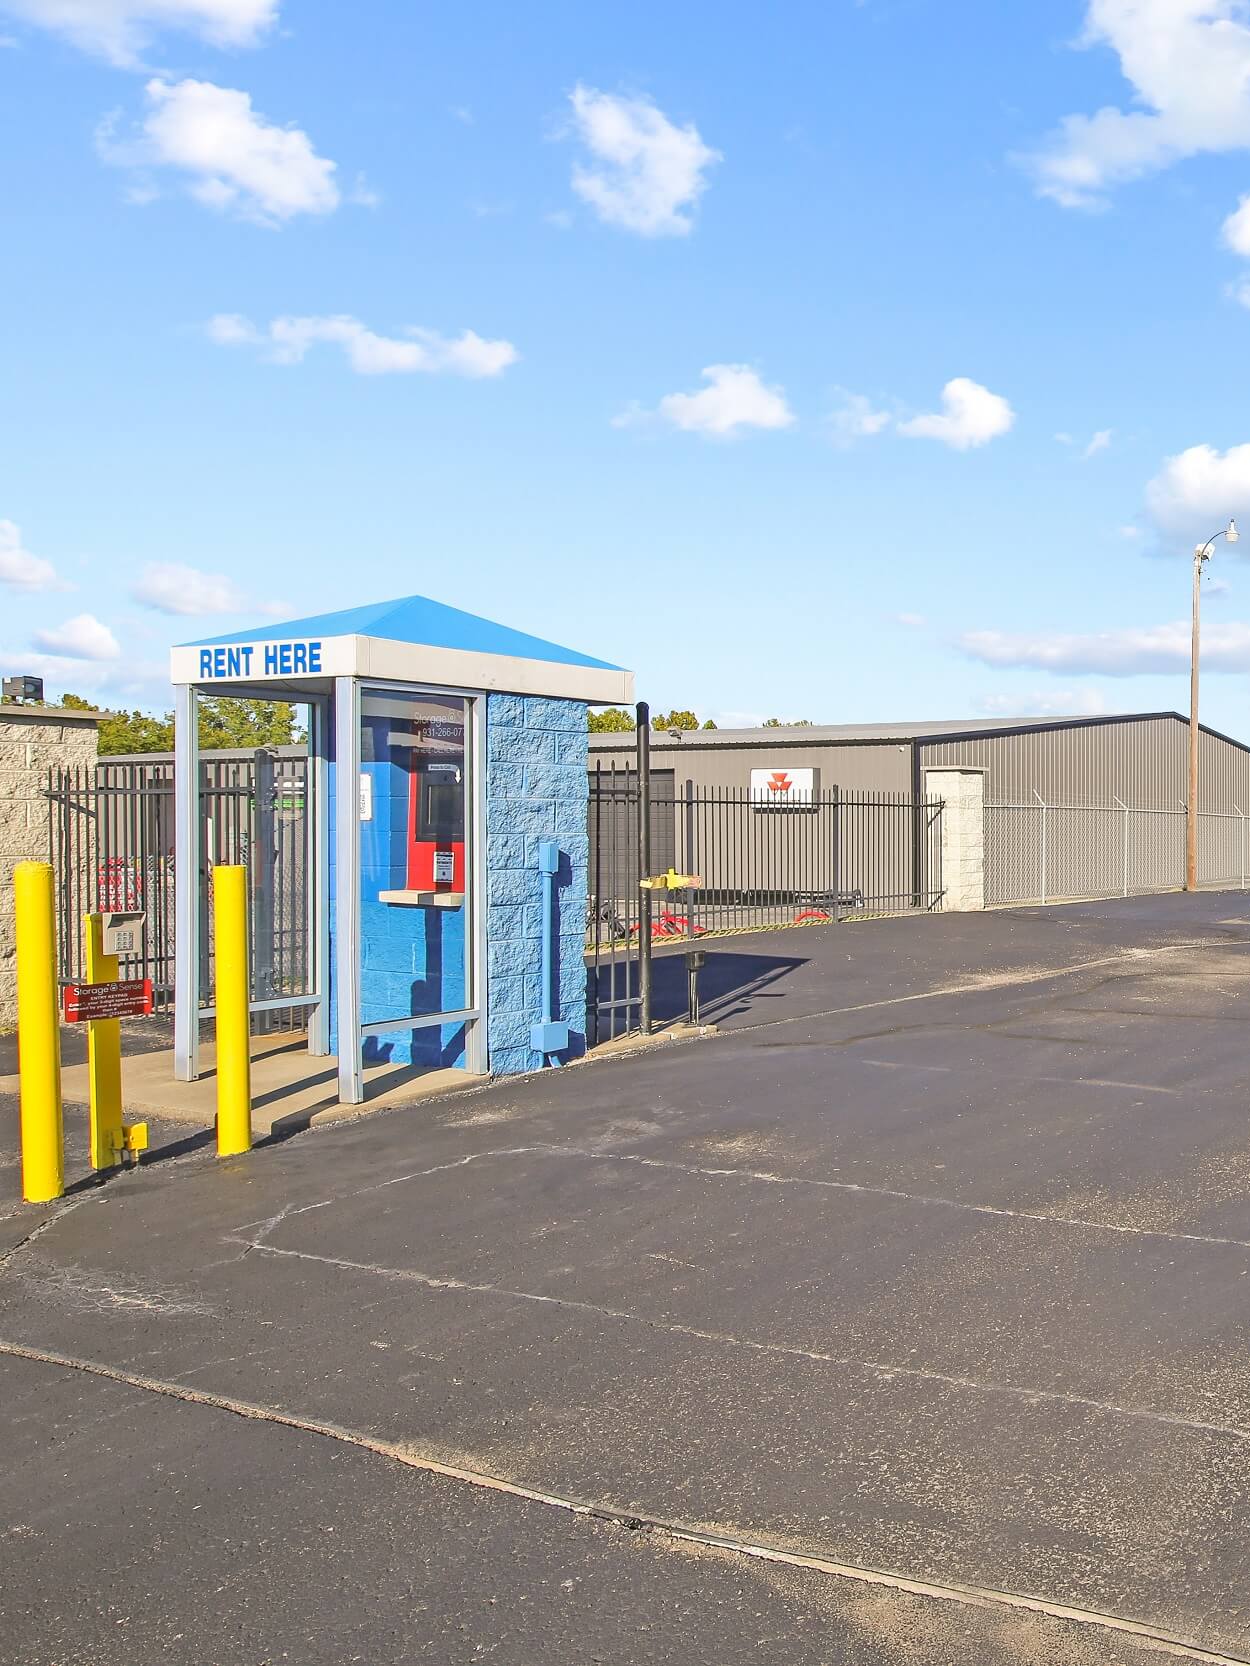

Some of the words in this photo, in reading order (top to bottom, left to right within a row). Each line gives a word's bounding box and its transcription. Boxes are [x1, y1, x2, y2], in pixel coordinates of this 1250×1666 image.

[200, 647, 253, 678] RENT
[265, 642, 321, 675] HERE
[414, 712, 447, 727] Storage
[423, 728, 464, 736] 931-266-07
[74, 986, 109, 995] Storage
